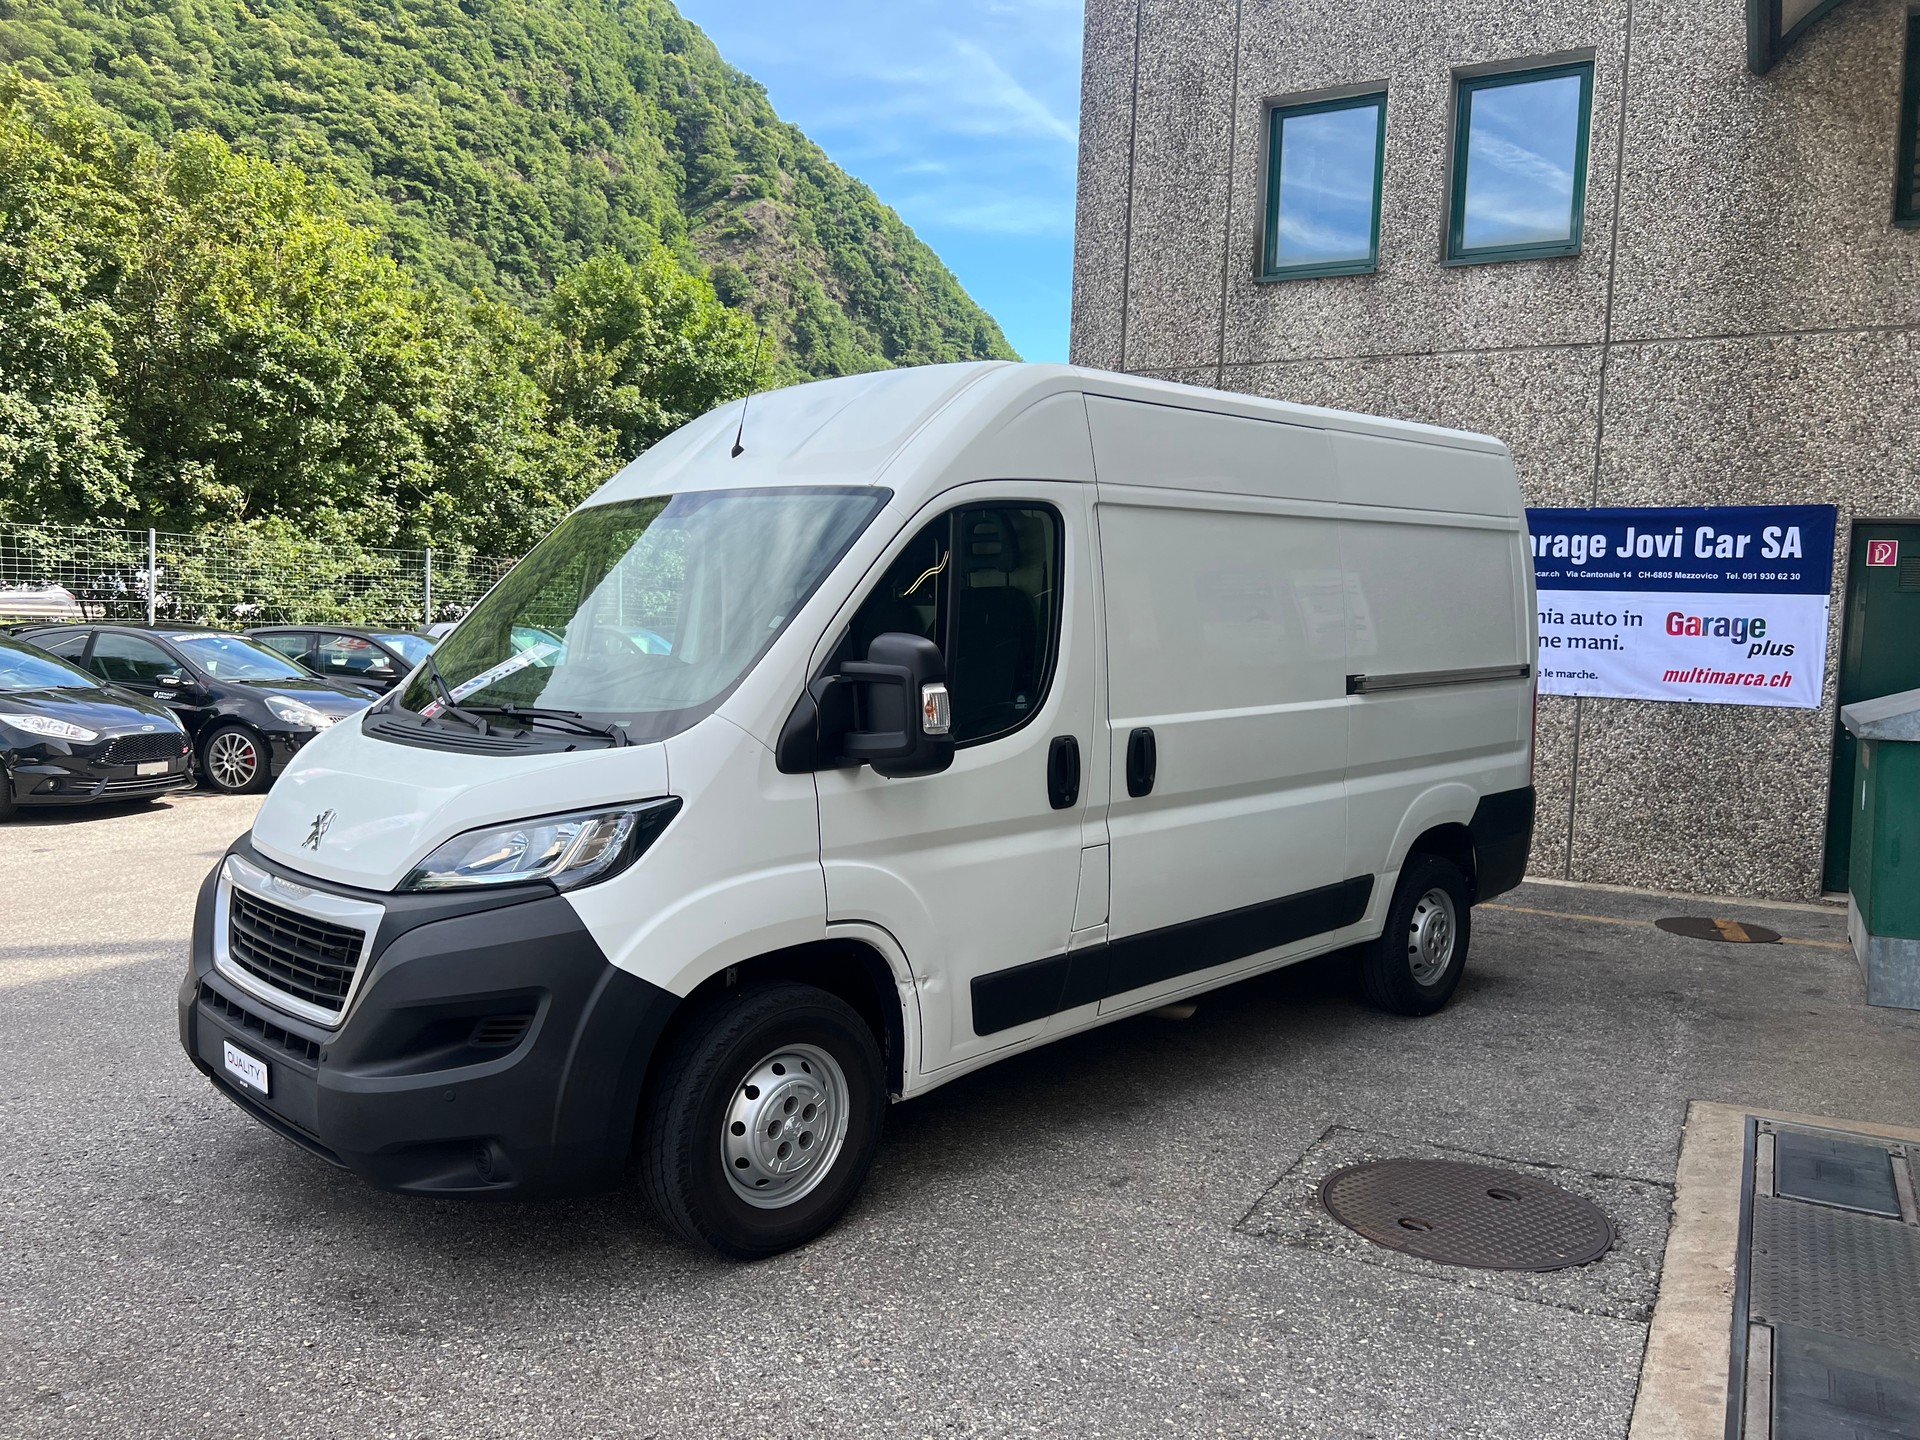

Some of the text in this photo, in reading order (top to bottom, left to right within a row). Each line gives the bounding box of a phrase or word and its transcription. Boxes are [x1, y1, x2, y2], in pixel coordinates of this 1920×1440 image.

[1616, 526, 1684, 558] Jovi
[1694, 526, 1751, 559] Car
[1761, 526, 1803, 559] SA
[1565, 570, 1579, 578] Via
[1580, 570, 1620, 578] Cantonale
[1638, 571, 1673, 579] CH-6805
[1674, 571, 1719, 580] Mezzovico
[1725, 572, 1741, 580] Tel.
[1742, 572, 1757, 580] 091
[1759, 572, 1776, 580] 930
[1777, 572, 1788, 580] 62
[1789, 572, 1801, 581] 30
[1570, 611, 1618, 626] auto
[1622, 610, 1643, 627] in
[1665, 611, 1766, 645] Garage
[1567, 634, 1625, 651] mani.
[1747, 640, 1796, 659] plus
[1544, 668, 1554, 678] le
[1555, 669, 1599, 680] marche.
[1662, 667, 1793, 688] multimarca.ch
